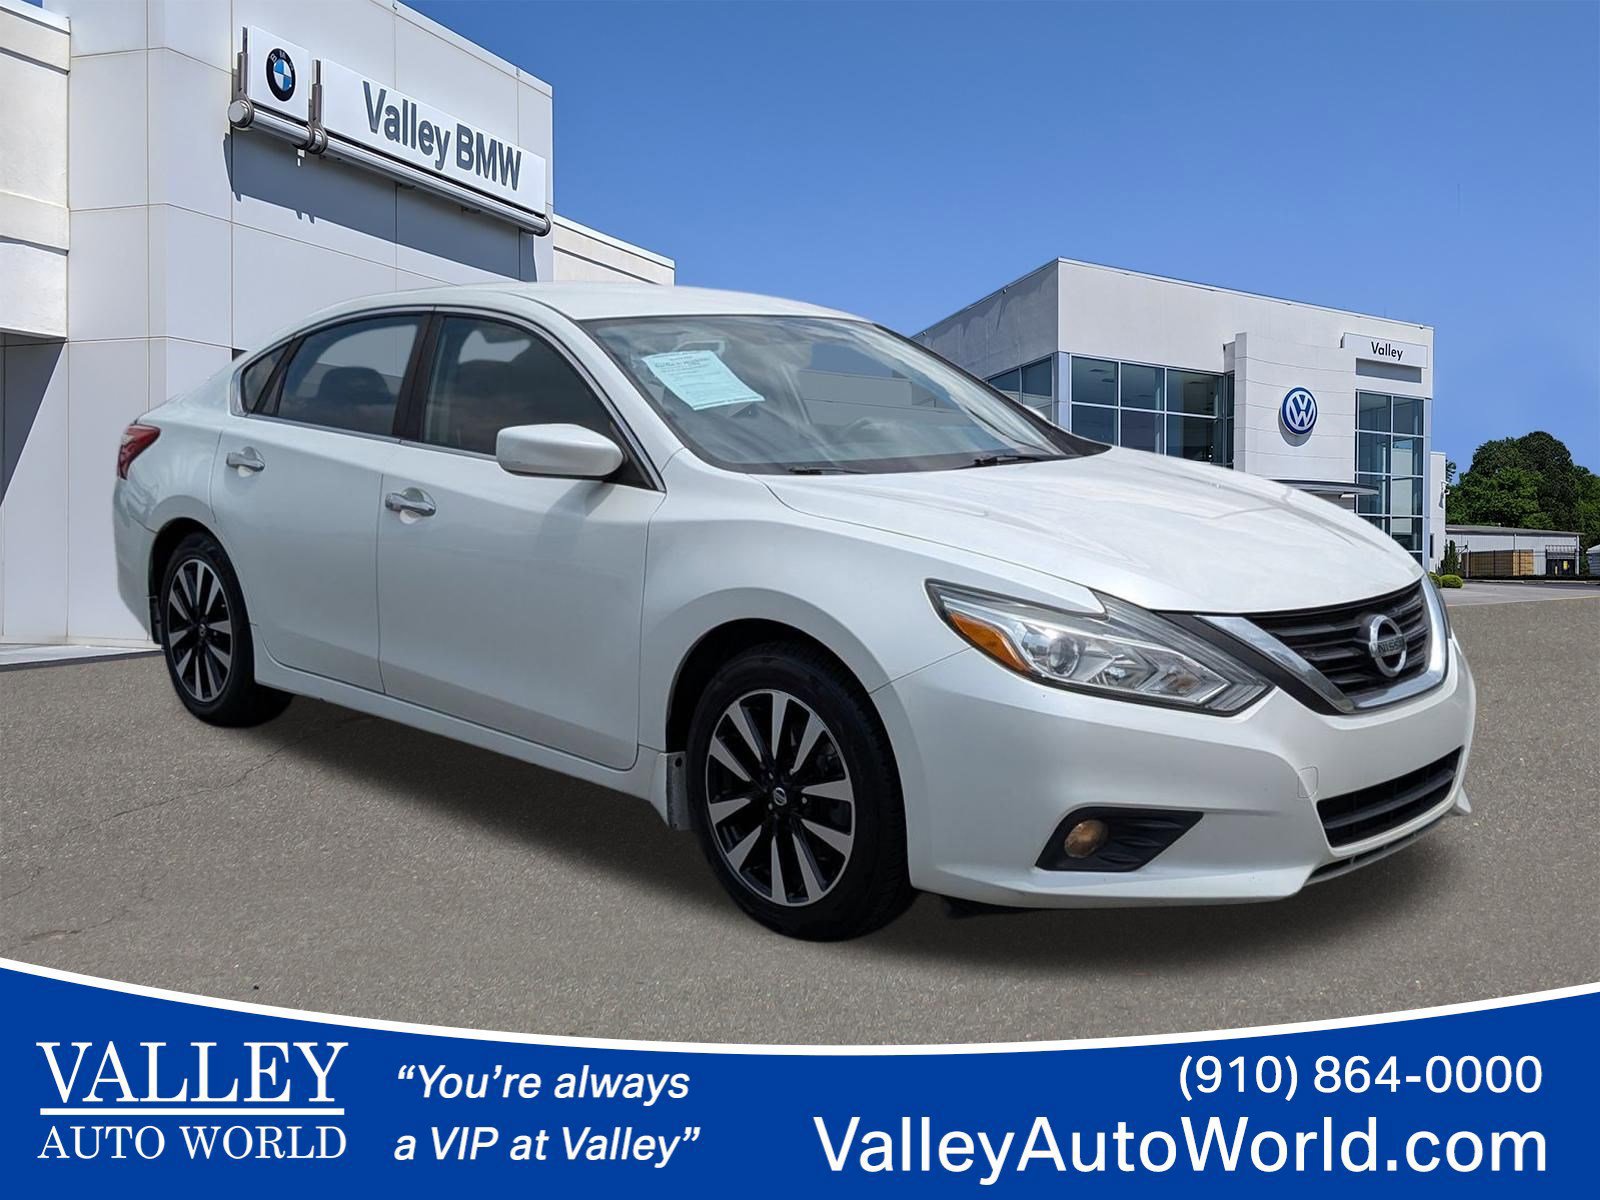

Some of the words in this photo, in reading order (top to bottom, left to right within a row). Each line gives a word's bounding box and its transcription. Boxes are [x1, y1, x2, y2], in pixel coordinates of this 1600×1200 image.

[362, 80, 451, 171] Valley
[456, 123, 522, 191] BMW
[1371, 341, 1403, 361] Valley
